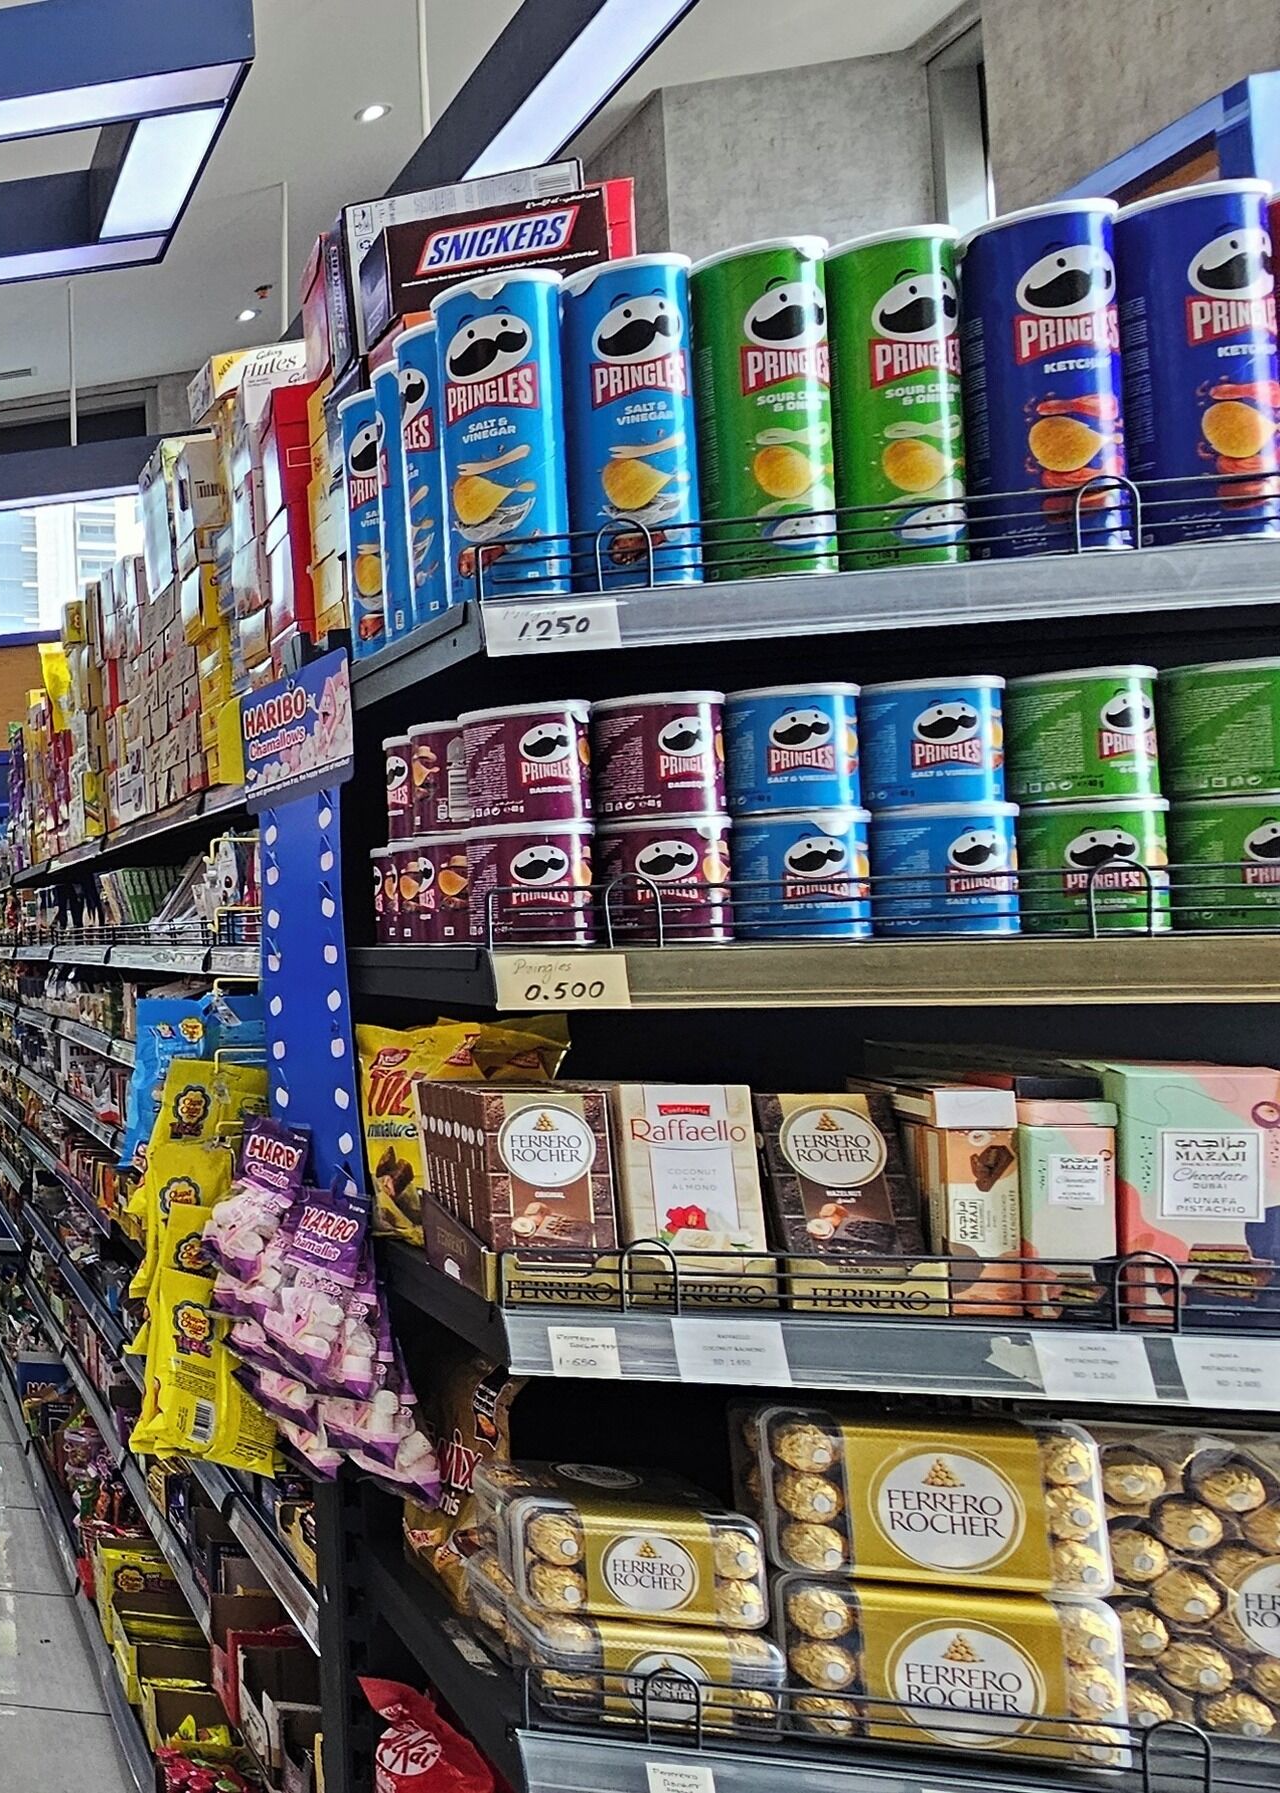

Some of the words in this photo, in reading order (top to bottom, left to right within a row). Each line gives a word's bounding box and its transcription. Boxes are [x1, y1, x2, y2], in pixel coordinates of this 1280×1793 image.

[427, 214, 568, 266] SNICKERS
[1020, 309, 1119, 358] PRINGES
[218, 356, 234, 379] NEW
[241, 354, 297, 379] Flutes
[748, 346, 829, 388] PRINGES
[1044, 356, 1112, 373] KETCH
[594, 357, 685, 403] PRINGLES
[447, 368, 534, 421] PRINGLES
[757, 392, 795, 405] SOUR
[885, 386, 926, 398] SOUR
[617, 409, 673, 425] VINEGAR
[624, 403, 655, 415] SALT
[462, 425, 517, 443] VINEGAR
[468, 421, 493, 432] SALT
[495, 417, 508, 425] &
[244, 686, 306, 739] HARIBO
[249, 726, 306, 760] Chamallows
[912, 738, 984, 767] PRINGLES
[770, 746, 835, 773] PRINGLES
[520, 758, 574, 784] PRINGLES
[524, 980, 605, 1001] 0.500
[367, 1121, 420, 1138] miniature
[630, 1118, 746, 1143] Raffaello
[510, 1134, 581, 1149] FERRERO
[793, 1134, 871, 1148] FERRERO
[512, 1148, 584, 1164] ROCHER
[795, 1148, 875, 1164] ROCHER
[1175, 1150, 1247, 1162] MAZAJI
[667, 1168, 718, 1176] COCONUT
[1172, 1169, 1249, 1184] Chocolate
[672, 1183, 717, 1191] ALMOND
[1175, 1205, 1246, 1214] PISTACHIO
[1184, 1196, 1238, 1205] KUNAFA
[970, 1201, 979, 1239] MAZAJI
[887, 1489, 1003, 1516] FERRERO
[889, 1510, 1007, 1539] ROCHER
[612, 1558, 685, 1577] FERRERO
[612, 1574, 685, 1591] ROCHER
[905, 1663, 1023, 1691] FERRERO
[907, 1684, 1019, 1713] ROCHER
